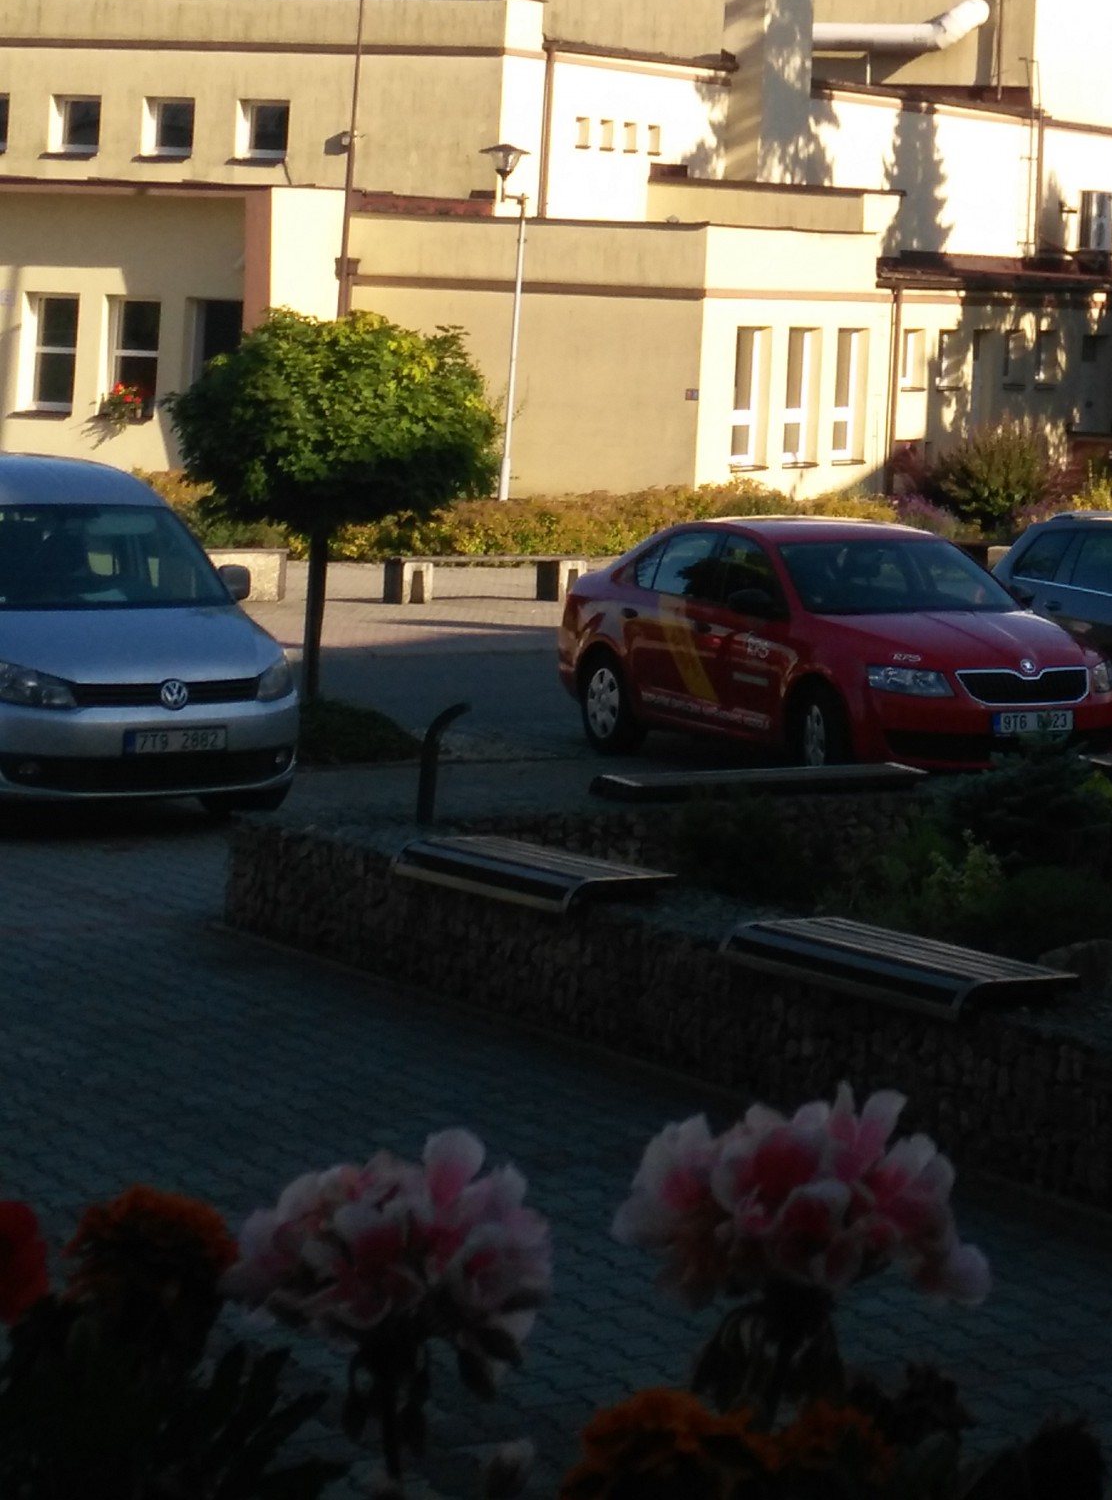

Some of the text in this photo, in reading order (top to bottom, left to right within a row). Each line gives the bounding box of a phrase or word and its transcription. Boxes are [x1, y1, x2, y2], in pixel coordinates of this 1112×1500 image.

[1003, 712, 1067, 731] 9T6 23
[139, 733, 169, 751] 7T9
